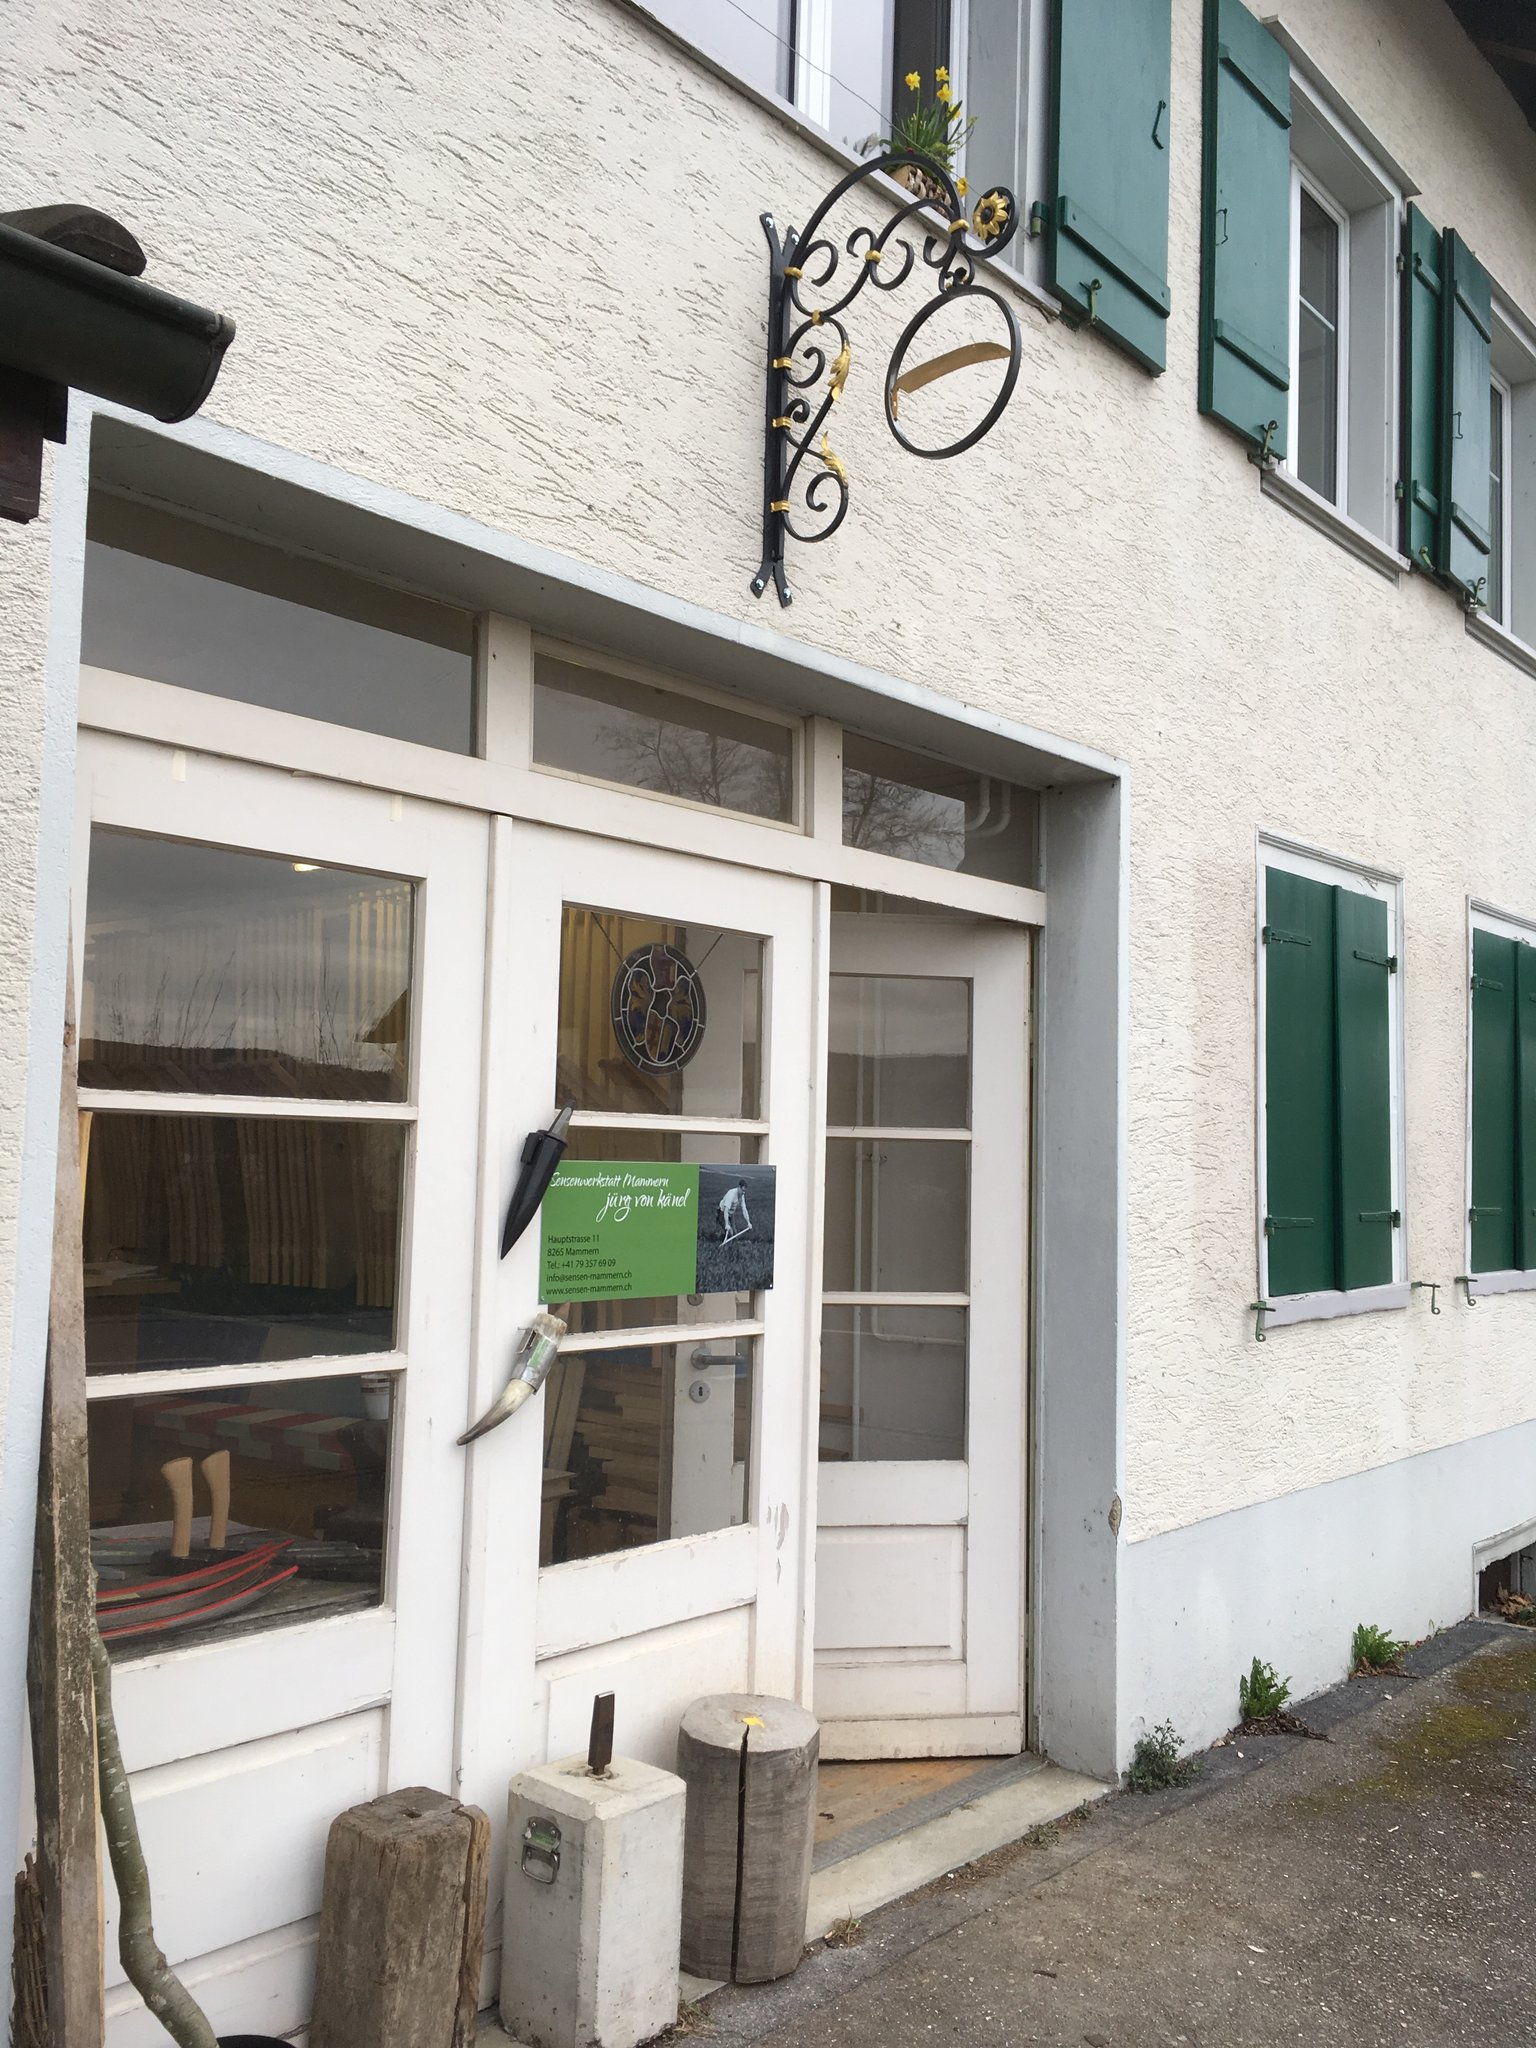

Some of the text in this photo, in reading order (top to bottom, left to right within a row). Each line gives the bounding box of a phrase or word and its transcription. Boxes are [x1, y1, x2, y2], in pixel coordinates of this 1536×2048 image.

[550, 1172, 668, 1188] Sensenwerkstatt Mammern
[596, 1188, 690, 1222] jürg von känel
[548, 1235, 590, 1245] Hauptstrasse
[608, 1259, 616, 1267] 09
[546, 1271, 632, 1282] info@sensen-mammern.ch
[546, 1284, 632, 1295] www.sensen-mammern.ch
